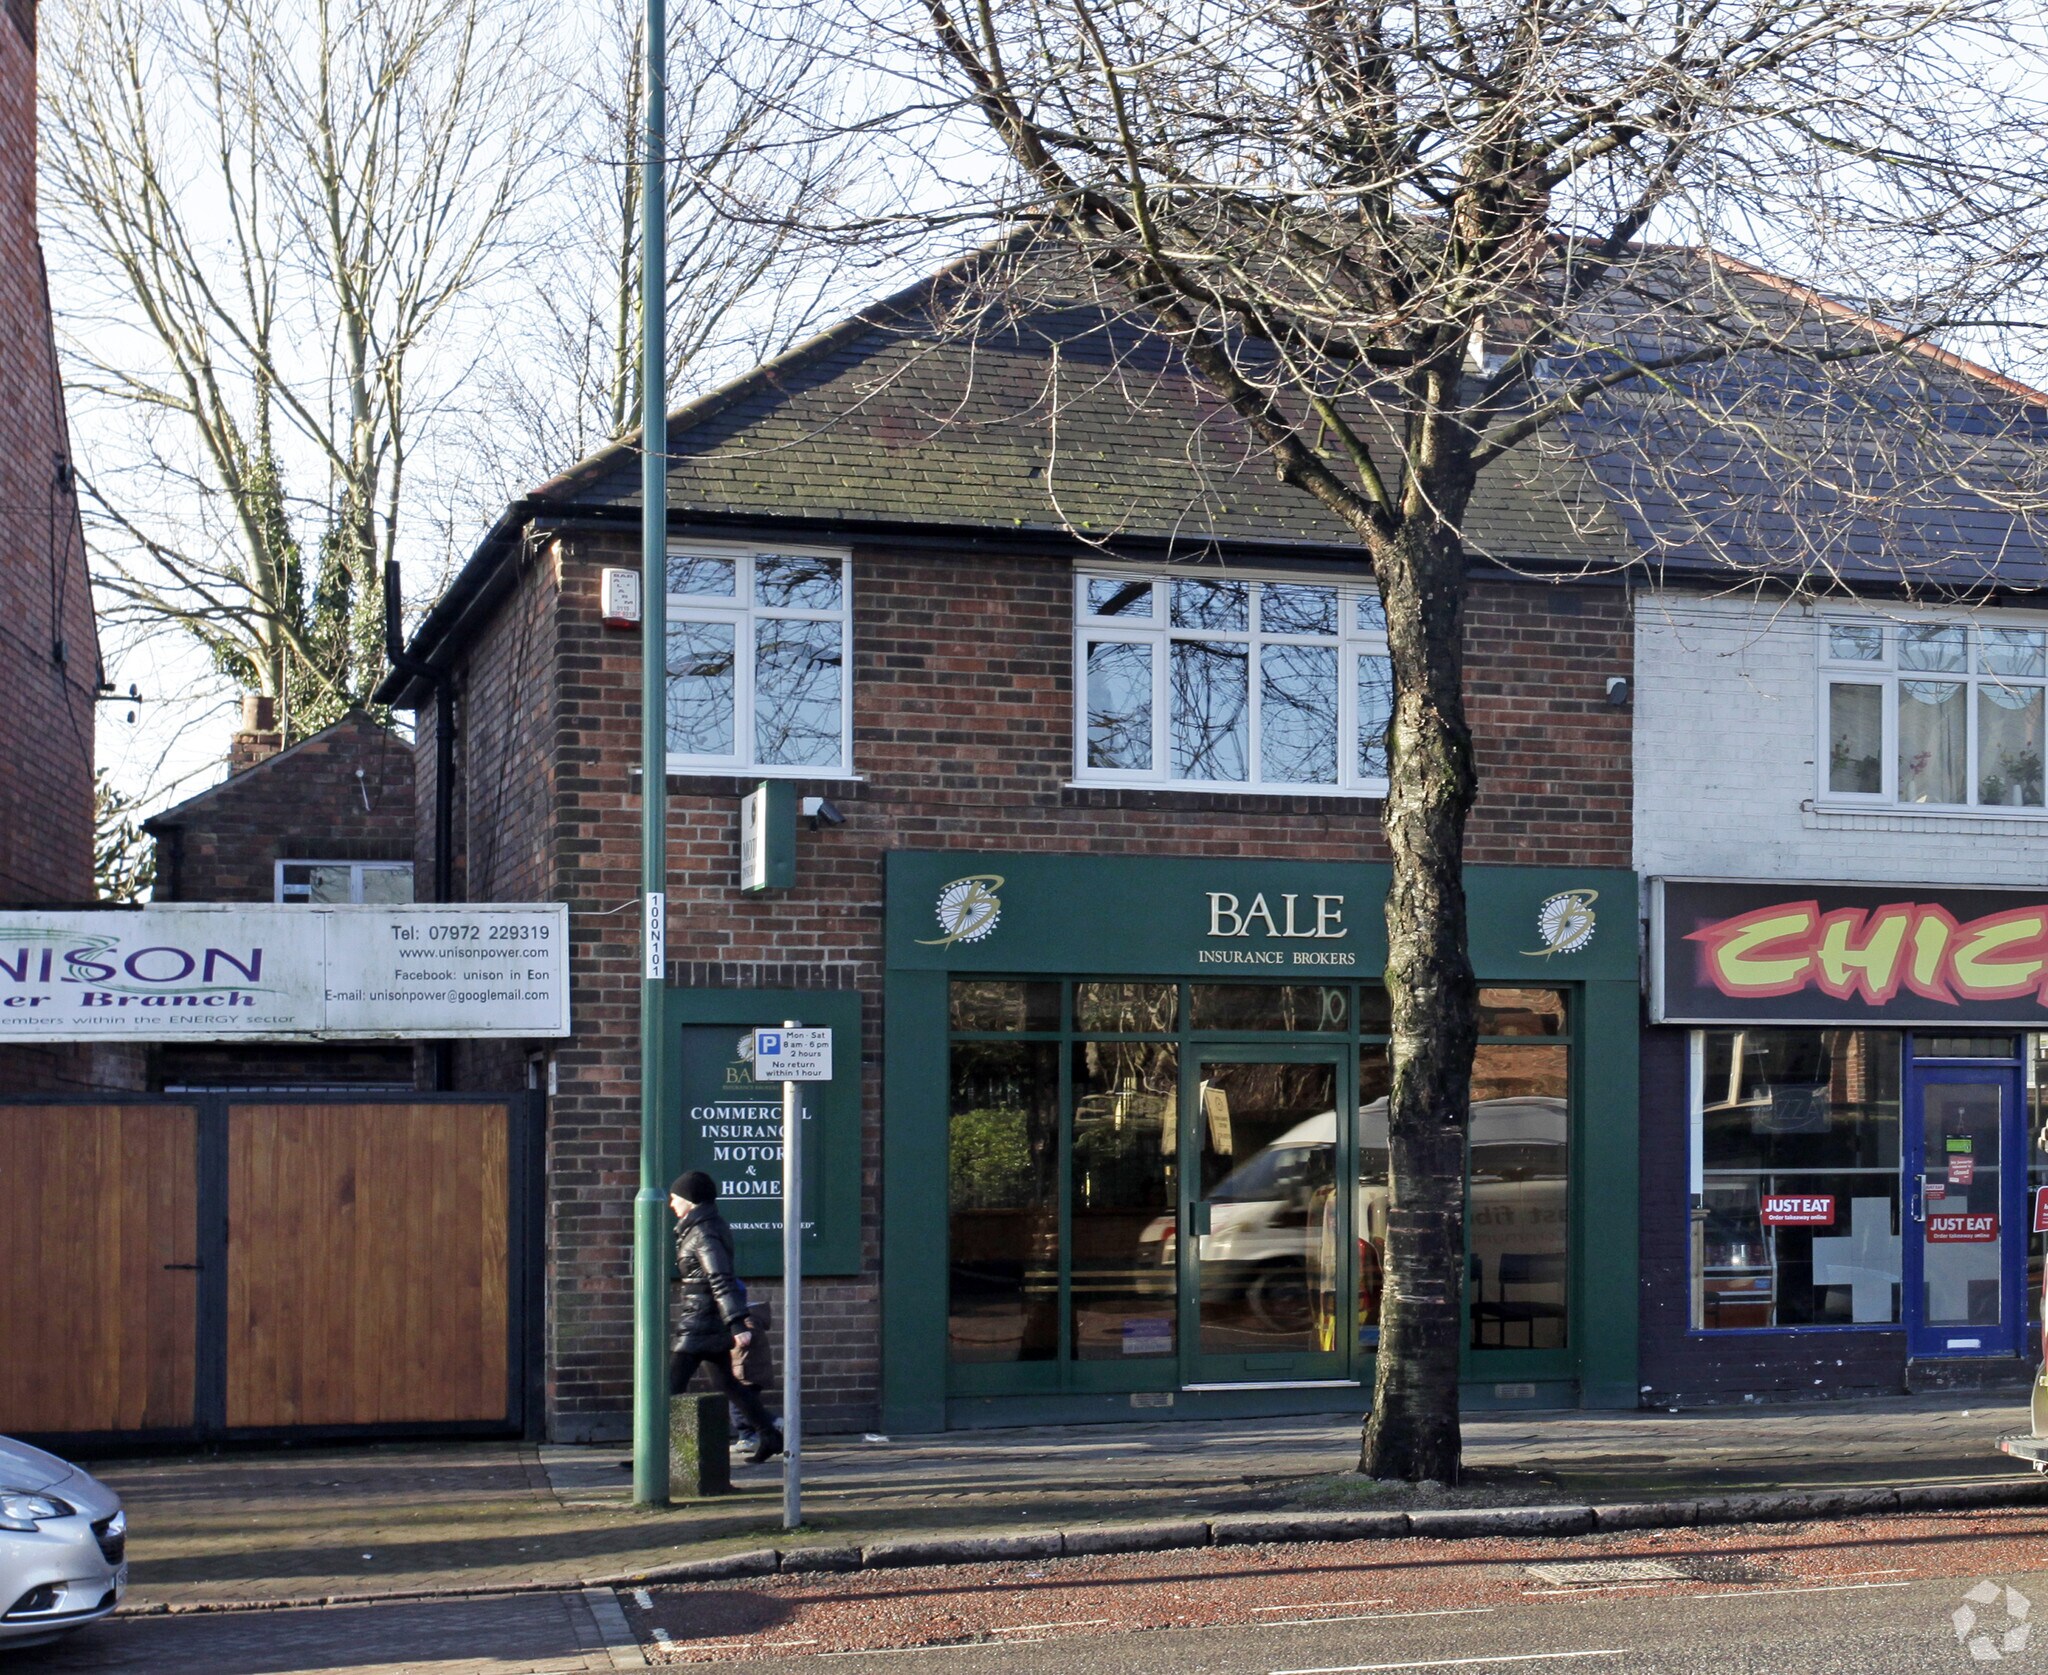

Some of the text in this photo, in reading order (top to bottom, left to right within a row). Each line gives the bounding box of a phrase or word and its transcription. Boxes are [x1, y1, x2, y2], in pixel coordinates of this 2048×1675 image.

[1205, 892, 1348, 938] BALE
[391, 925, 550, 940] Tel: 07972 229319
[650, 895, 661, 977] 100N101
[399, 946, 549, 961] www.unisonpower.com
[1198, 950, 1356, 965] INSURANCE BROKERS
[394, 969, 550, 981] Facebook: unison in Eon
[3, 991, 257, 1008] er Branch
[325, 989, 550, 1004] E-mail: unisonpower@googlemail.com
[1, 1014, 296, 1025] embers within the ENERGY sector
[762, 1035, 778, 1054] P
[690, 1106, 812, 1120] COMMERCL
[745, 1164, 757, 1176] &
[721, 1180, 781, 1195] HOME
[1765, 1199, 1831, 1212] JUST EAT
[1930, 1217, 1994, 1231] JUST EAT
